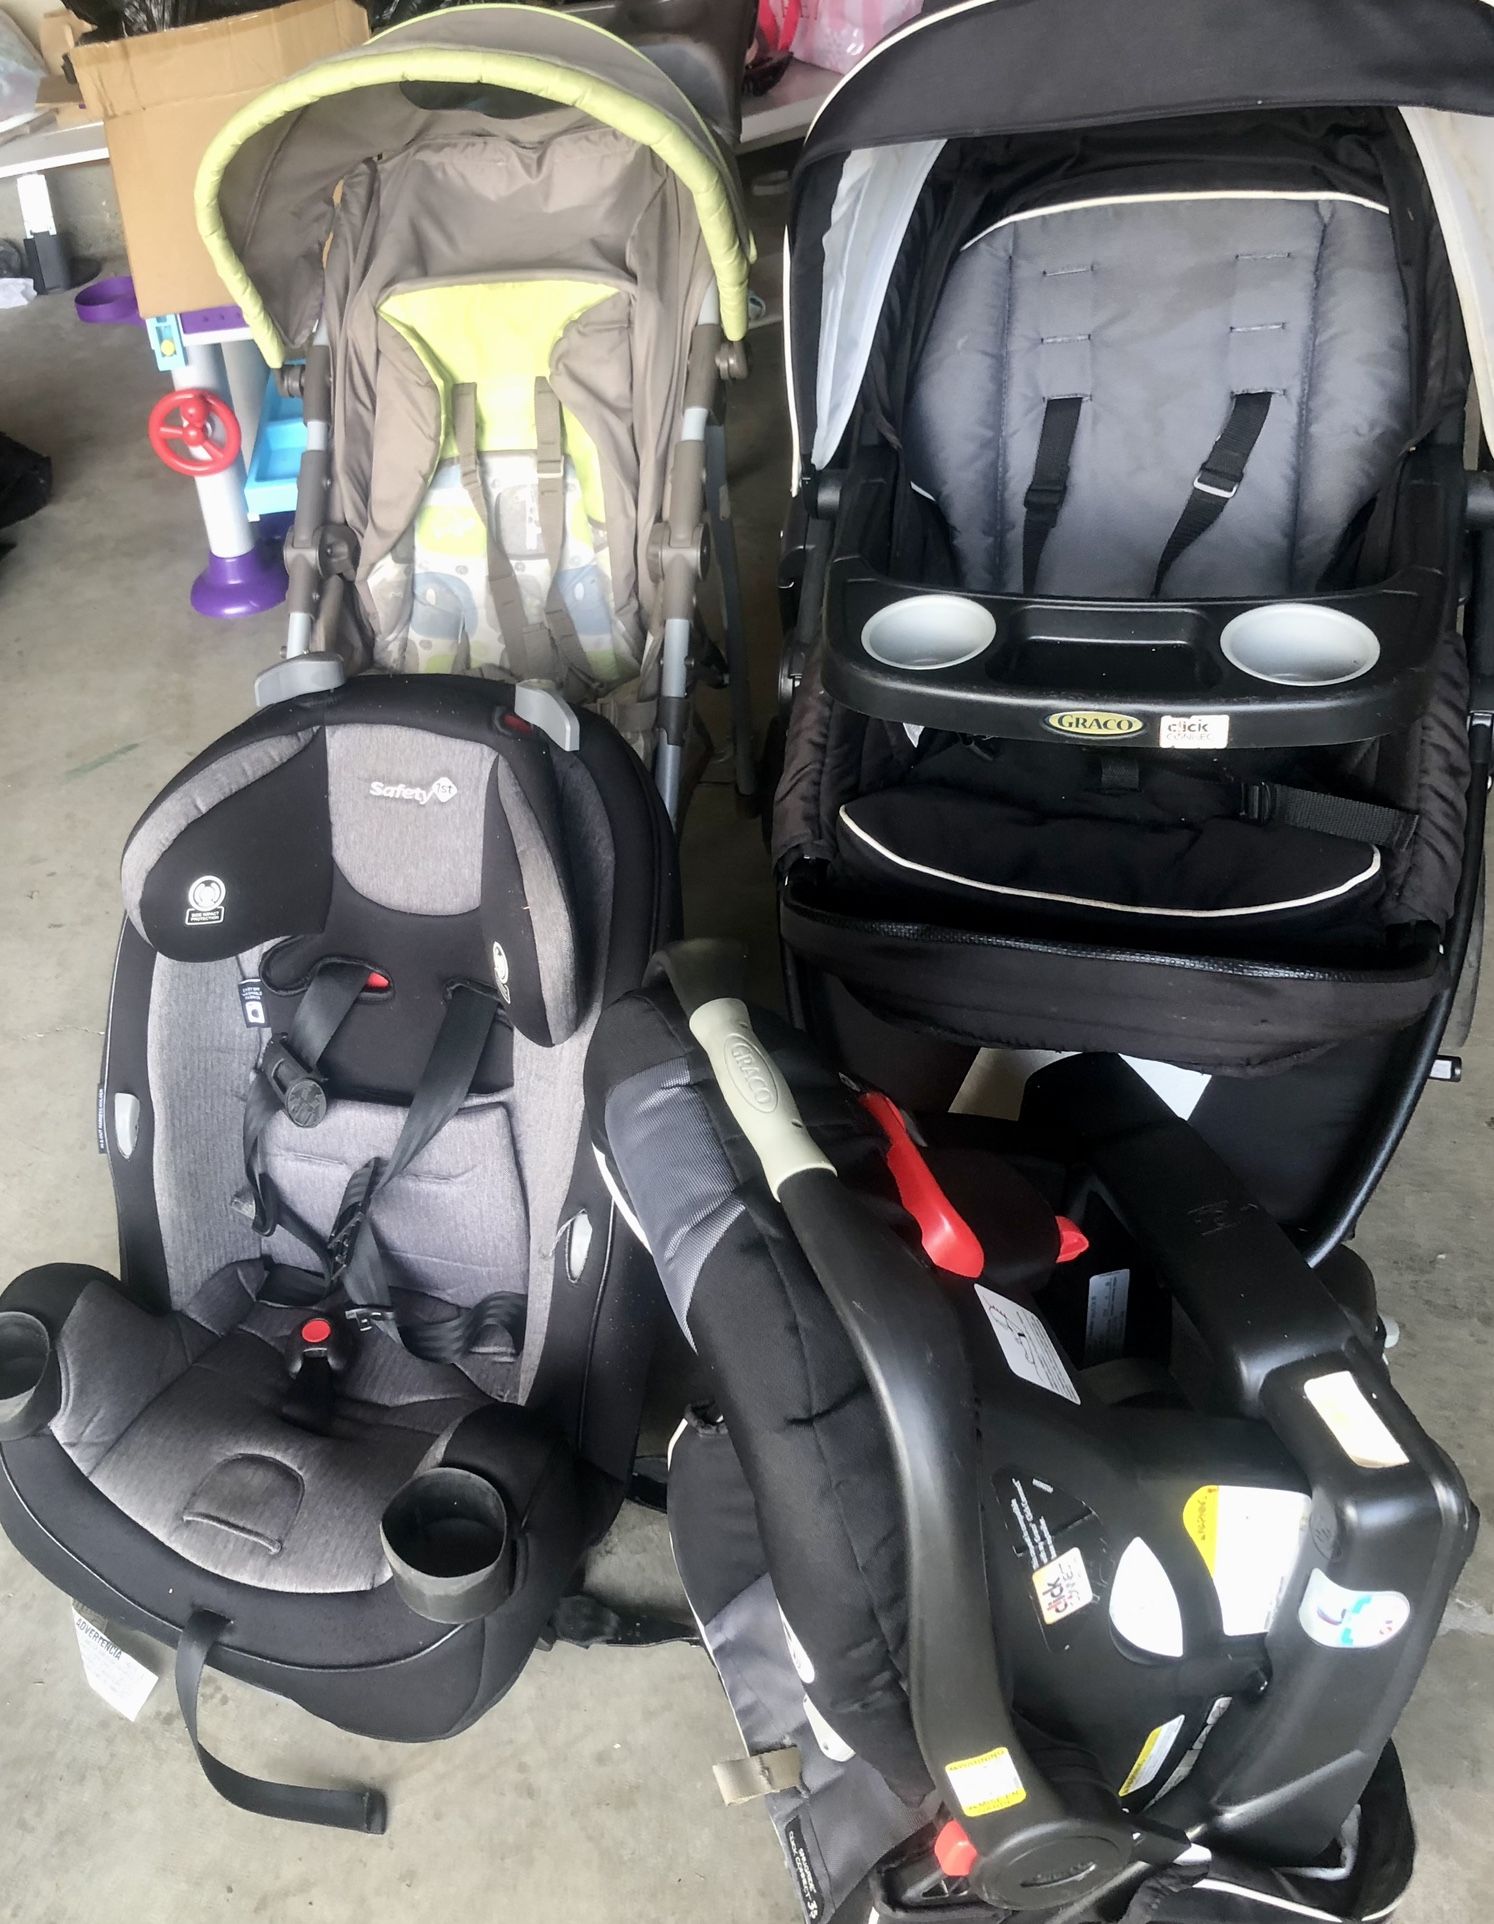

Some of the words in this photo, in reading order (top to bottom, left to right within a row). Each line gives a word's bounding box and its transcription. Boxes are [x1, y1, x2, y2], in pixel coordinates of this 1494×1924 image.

[1057, 713, 1134, 731] GRACO
[369, 781, 434, 805] Safety
[732, 1043, 772, 1103] GRACO
[1043, 1577, 1068, 1613] click
[76, 1617, 122, 1661] ADVERTENCIA
[807, 1900, 818, 1919] 35
